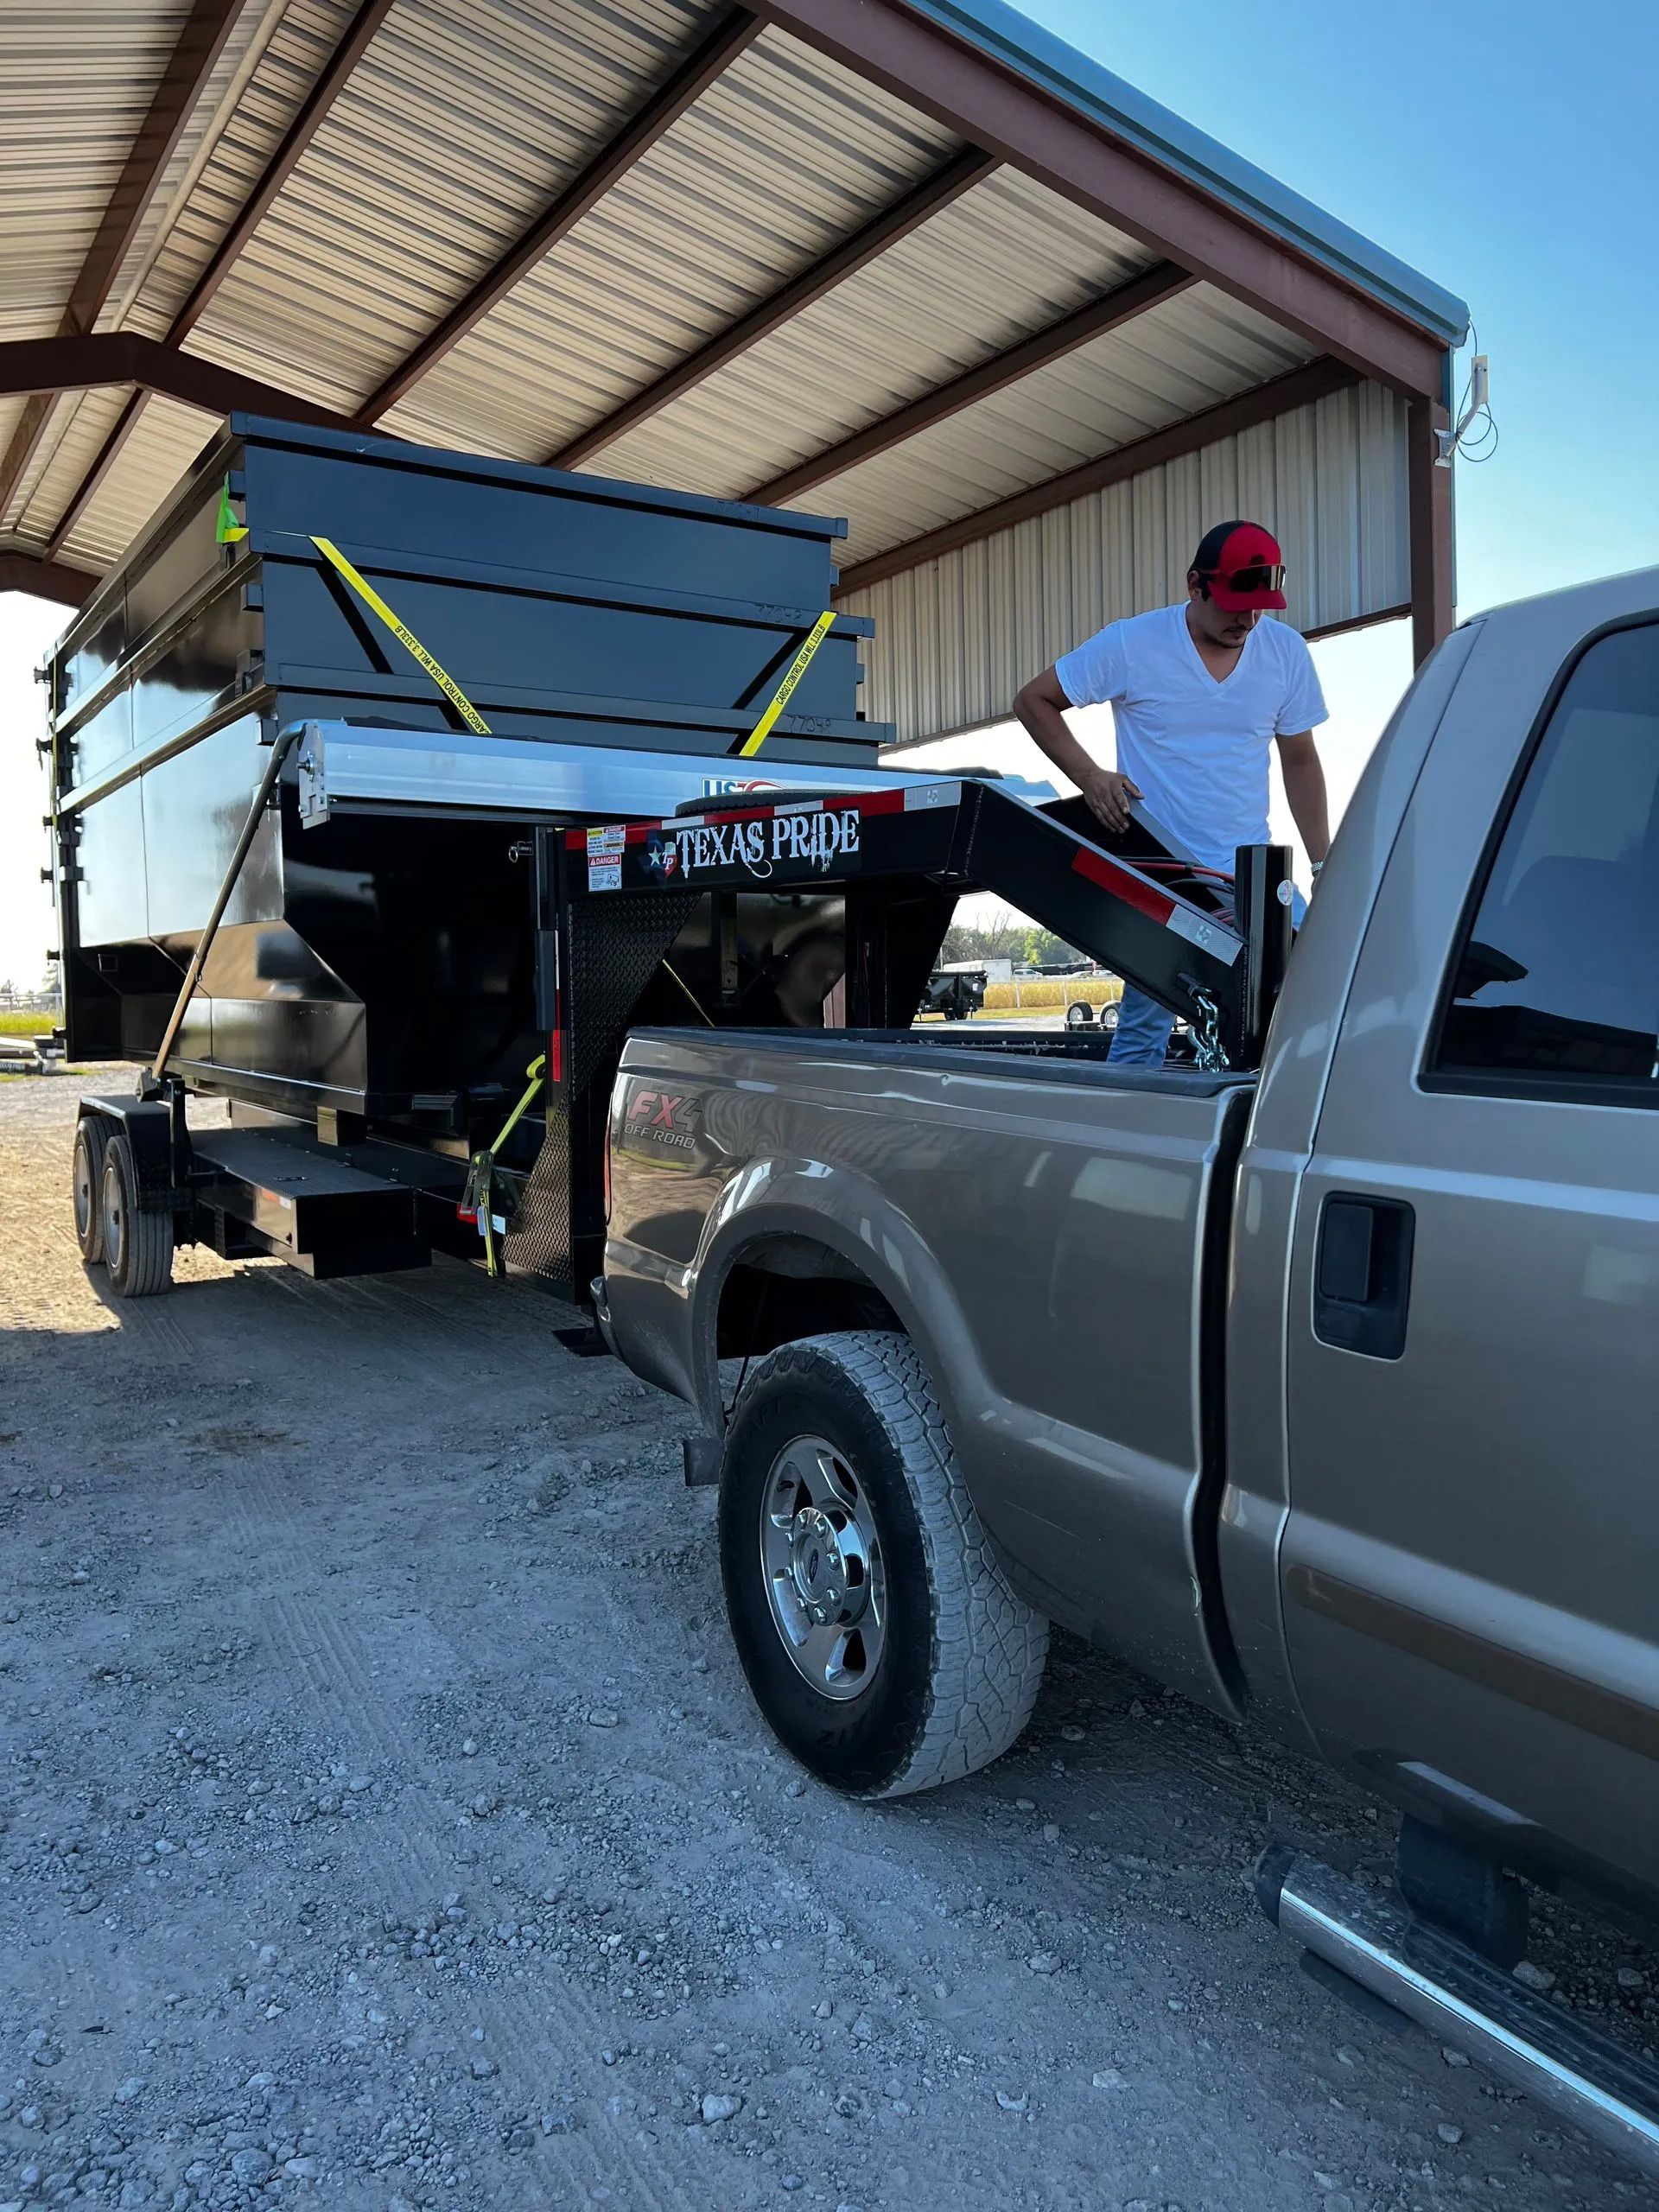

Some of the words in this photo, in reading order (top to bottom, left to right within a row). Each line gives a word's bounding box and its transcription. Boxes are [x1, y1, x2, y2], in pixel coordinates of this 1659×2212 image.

[418, 649, 432, 667] WLL
[430, 664, 445, 680] USA
[776, 684, 791, 705] CARGO
[785, 662, 804, 687] CONTROL
[799, 652, 810, 664] USA
[442, 680, 470, 713] CONTROL
[676, 822, 771, 878] TEXAS
[772, 810, 860, 871] PRIDE
[596, 855, 619, 865] DANGER
[628, 1090, 703, 1134] FX4
[624, 1123, 651, 1138] OFF
[652, 1129, 696, 1149] ROAD
